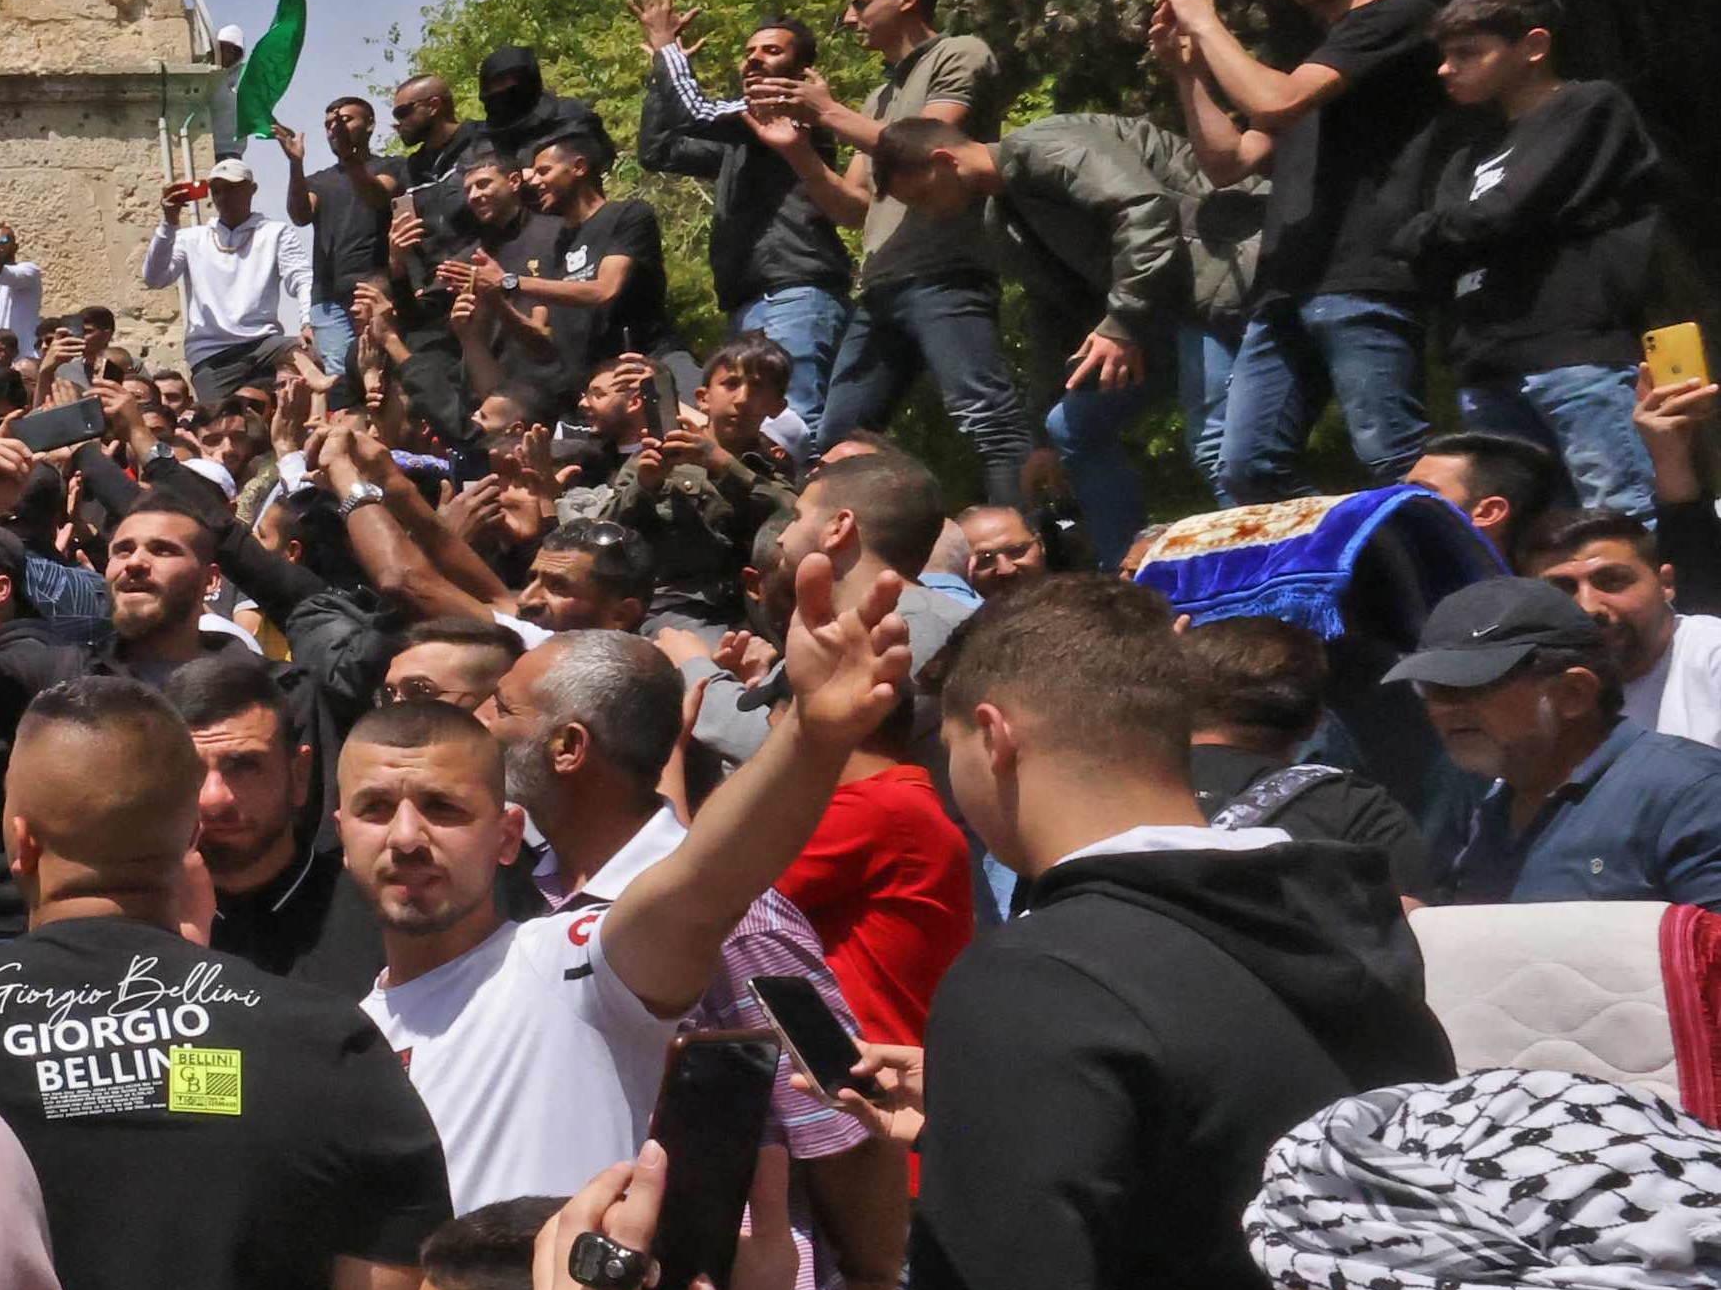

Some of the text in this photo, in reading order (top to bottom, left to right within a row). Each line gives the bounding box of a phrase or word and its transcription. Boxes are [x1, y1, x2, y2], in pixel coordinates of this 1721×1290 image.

[107, 955, 260, 1017] Bellini
[3, 1004, 210, 1057] GIORGIO
[36, 1042, 193, 1092] BELLIN
[179, 1053, 233, 1067] BELLINI
